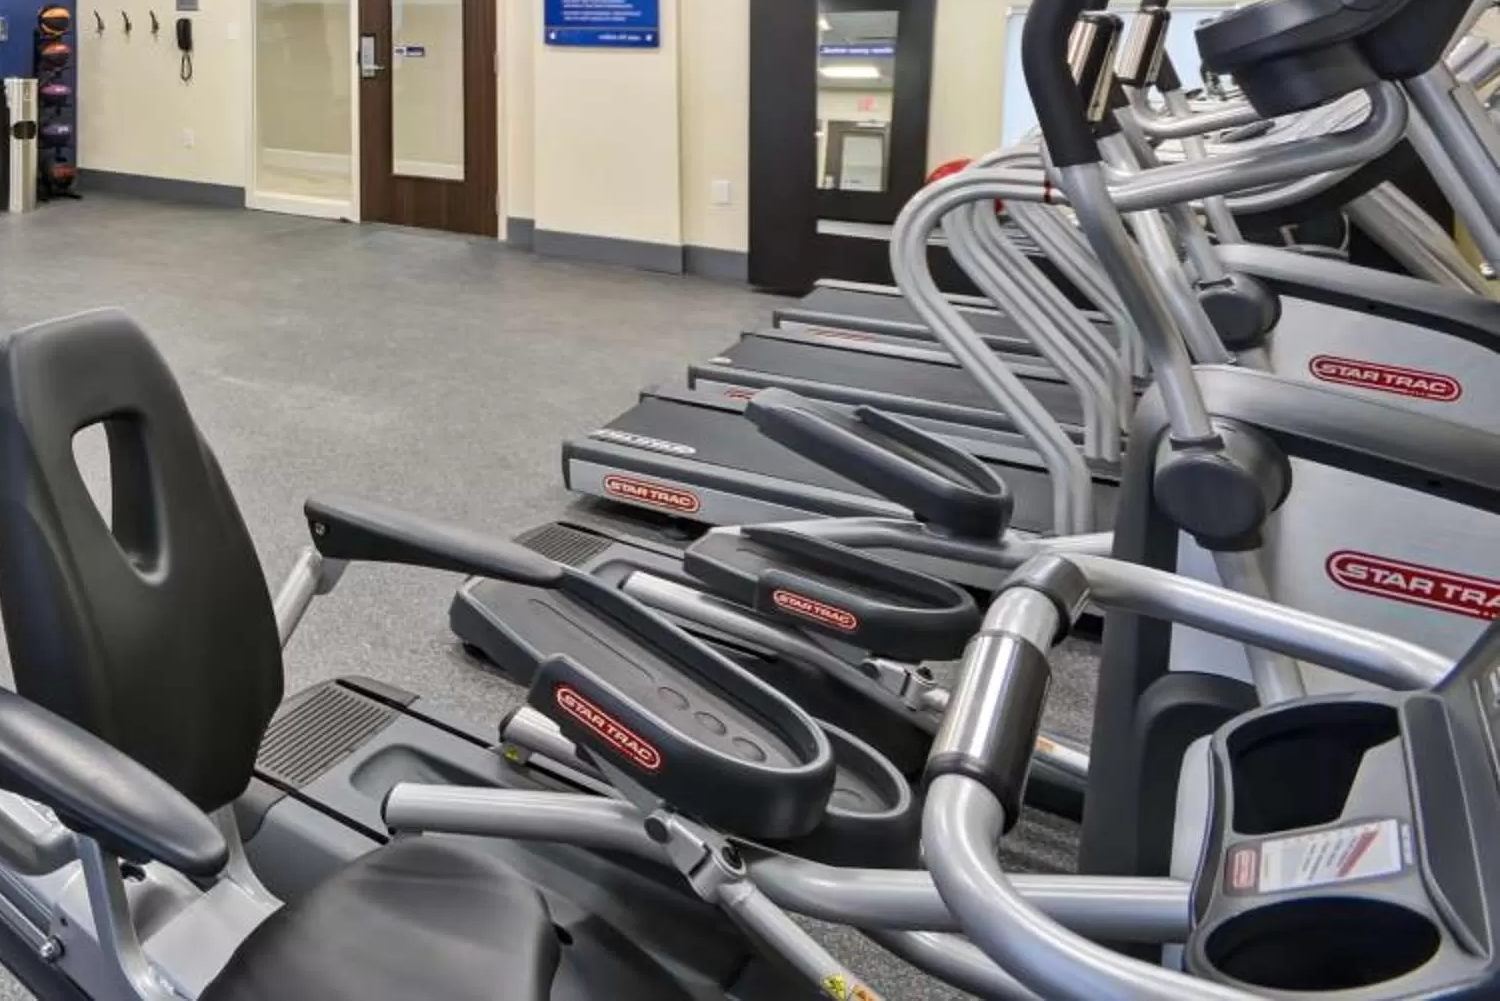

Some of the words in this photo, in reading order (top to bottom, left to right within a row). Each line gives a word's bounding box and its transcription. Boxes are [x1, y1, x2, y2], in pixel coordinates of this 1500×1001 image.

[1317, 363, 1379, 382] STAR
[1382, 374, 1448, 392] TRAC
[610, 480, 648, 497] STAR
[649, 489, 692, 506] TRAC
[1340, 562, 1435, 596] STAR
[1440, 583, 1500, 609] TRA
[778, 593, 813, 611] STAR
[814, 606, 851, 624] TRAC
[562, 694, 606, 728] STAR
[605, 723, 654, 760] TRAC
